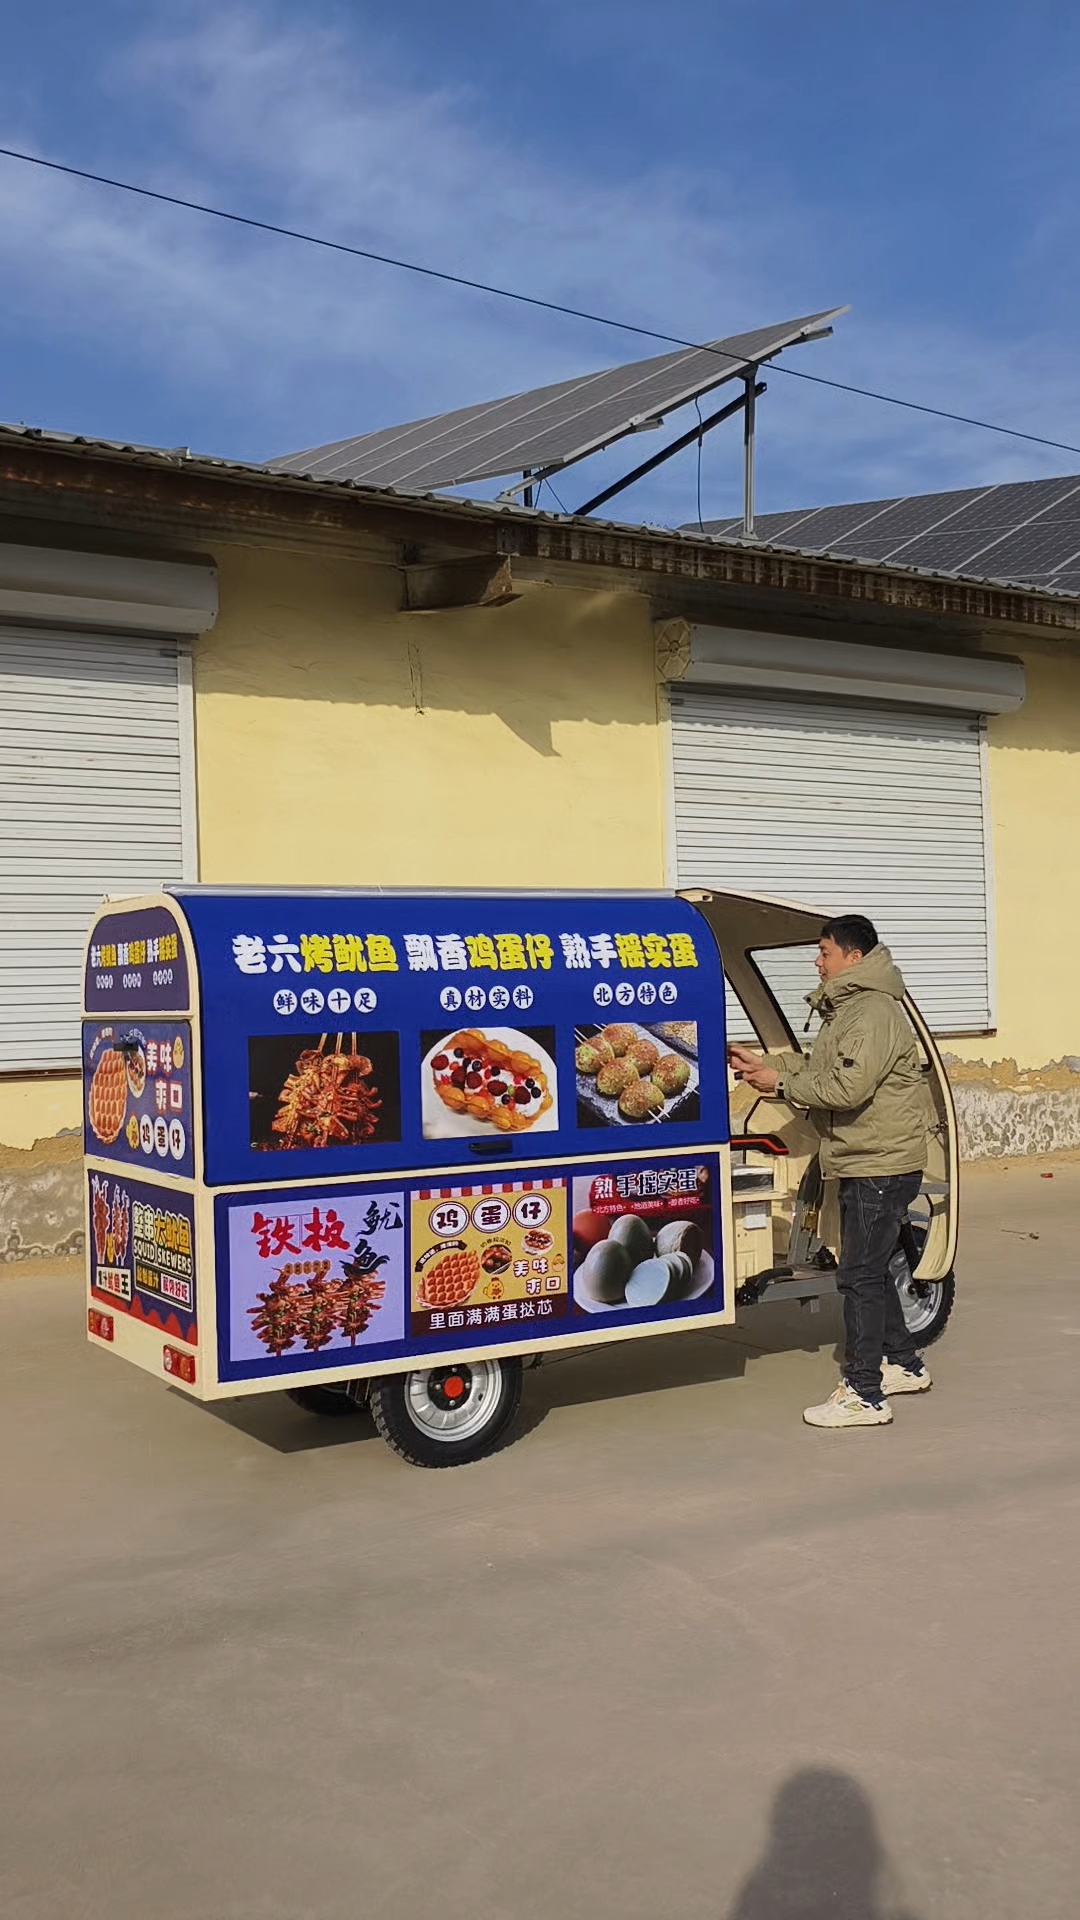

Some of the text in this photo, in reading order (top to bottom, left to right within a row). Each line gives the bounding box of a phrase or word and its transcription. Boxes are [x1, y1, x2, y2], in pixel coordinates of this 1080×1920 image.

[232, 933, 699, 974] 老六烤鱿鱼 飘香鸡蛋仔 熟手摇实蛋
[274, 984, 678, 1014] 鲜味十足 真材实料 北方特色
[146, 1041, 172, 1073] 美味
[155, 1080, 183, 1111] 爽口
[142, 1122, 182, 1152] 鸡蛋仔
[593, 1168, 698, 1200] 熟手摇实蛋
[133, 1202, 191, 1256] 整串大鱿鱼
[435, 1200, 543, 1230] 鸡蛋仔
[251, 1207, 350, 1258] 铁板
[339, 1201, 403, 1277] 鱿鱼
[133, 1239, 192, 1275] SQUID SKEWERS
[513, 1257, 549, 1278] 美味
[526, 1277, 561, 1295] 爽口
[428, 1299, 553, 1330] 里面满满蛋挞芯
